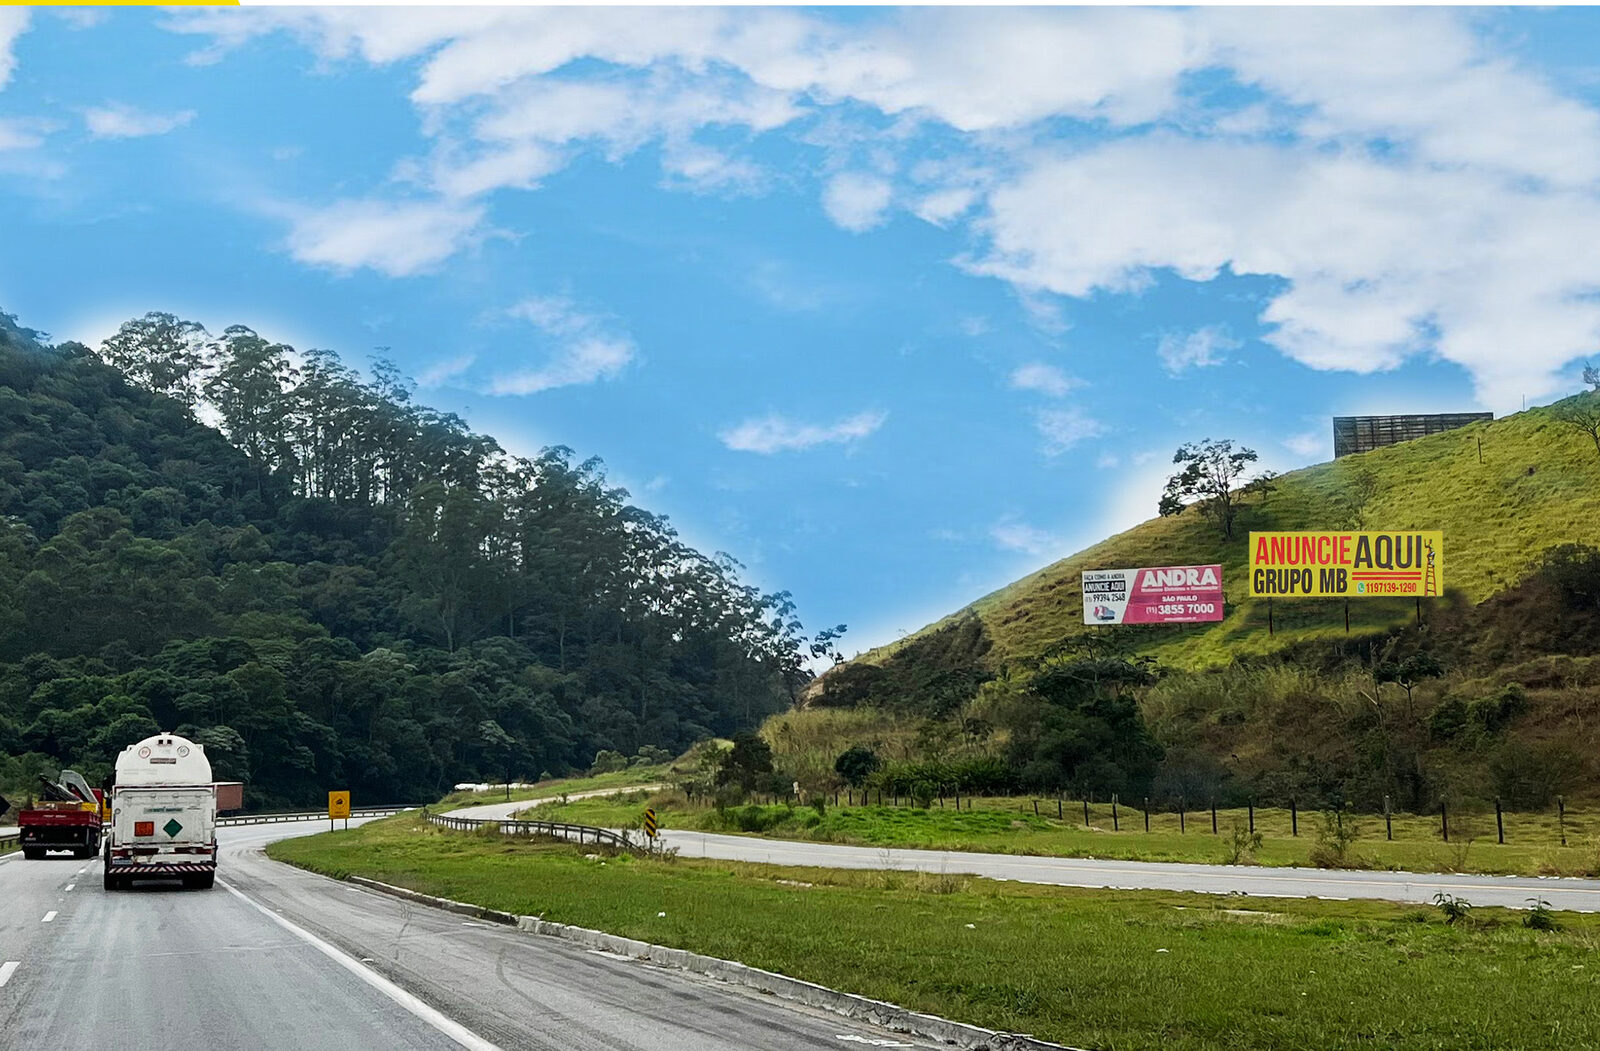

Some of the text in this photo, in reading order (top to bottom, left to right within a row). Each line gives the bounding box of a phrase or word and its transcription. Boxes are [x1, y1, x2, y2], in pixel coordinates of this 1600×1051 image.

[1255, 535, 1422, 570] ANUNCIE AQUI
[1141, 568, 1218, 588] ANDRA
[1254, 568, 1348, 594] GRUPO MB
[1085, 581, 1125, 592] ANUNCIE AQUI
[1366, 582, 1417, 593] 1197139-1290
[1158, 604, 1185, 615] 3855
[1186, 603, 1215, 614] 7000
